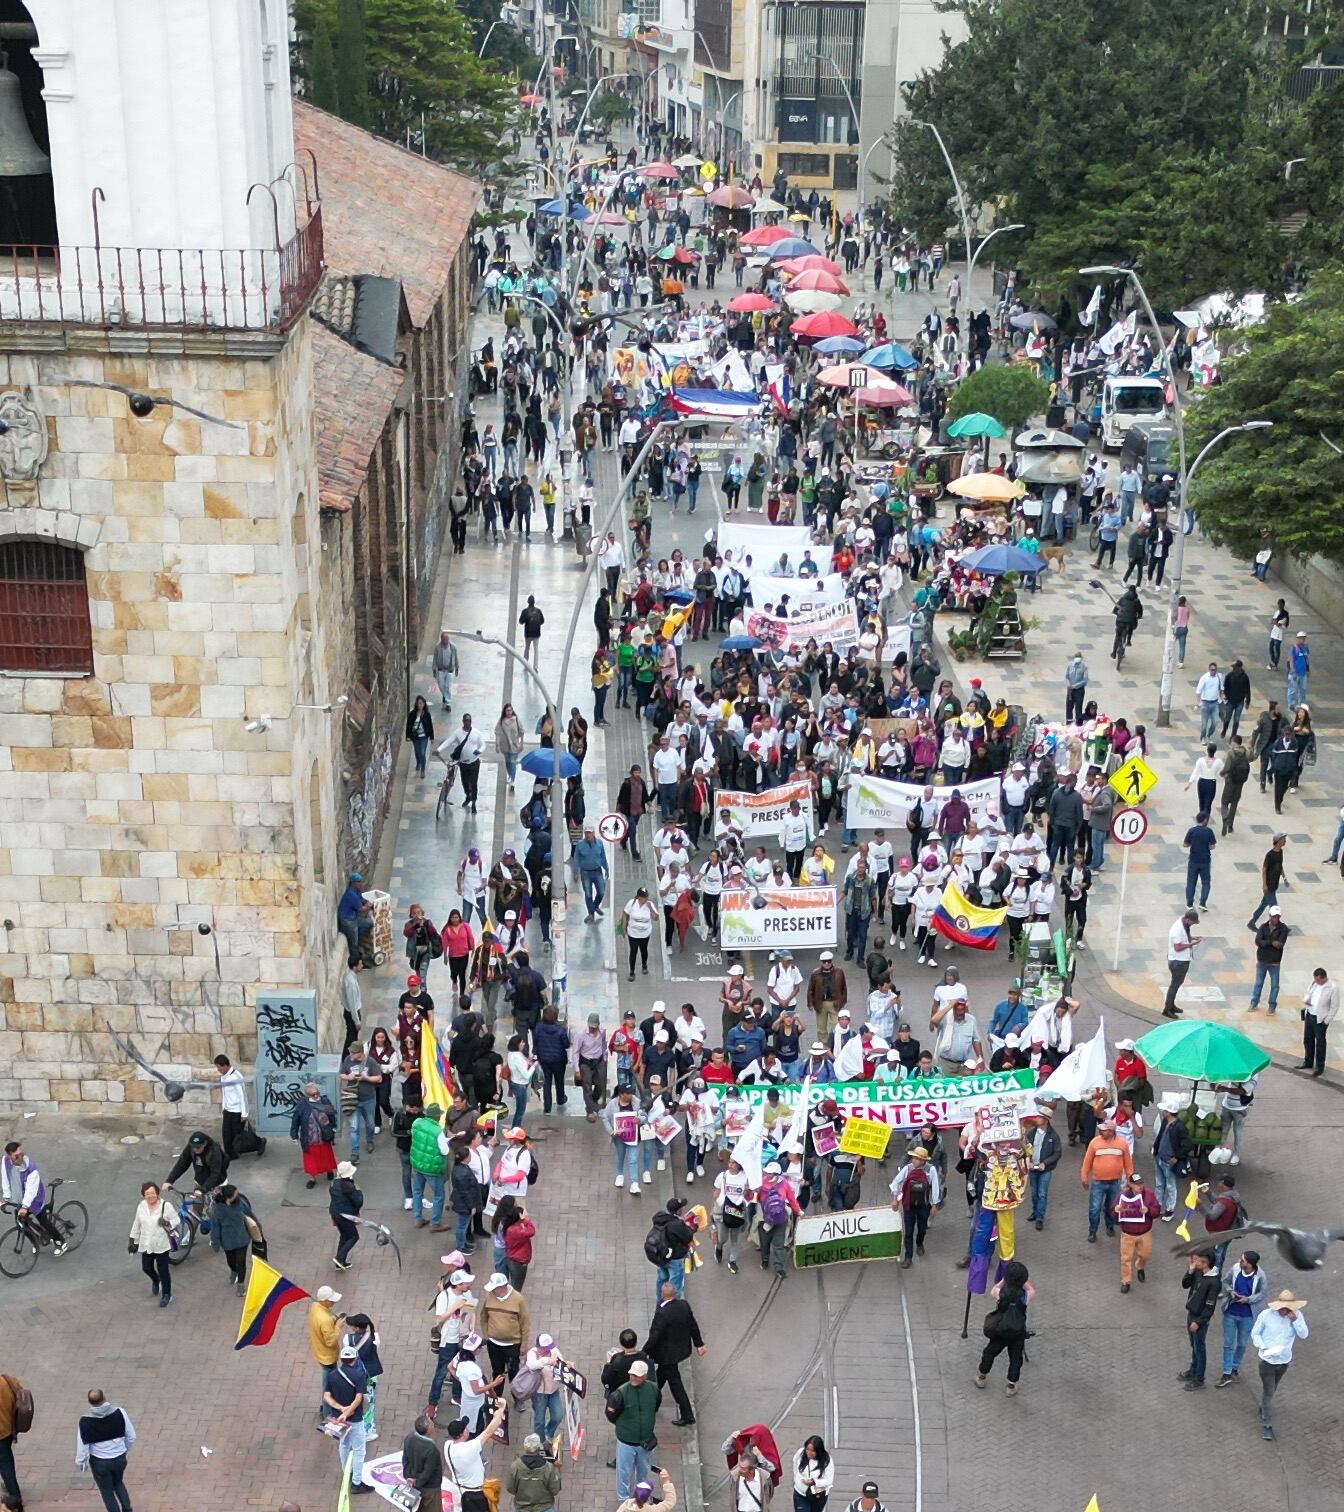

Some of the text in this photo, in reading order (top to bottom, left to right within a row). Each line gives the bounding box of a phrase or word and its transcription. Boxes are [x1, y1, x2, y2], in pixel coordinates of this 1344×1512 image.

[1120, 817, 1139, 835] 10
[764, 916, 832, 932] PRESENTE
[695, 952, 723, 966] PARE
[842, 1086, 869, 1103] DE
[819, 1215, 871, 1240] ANUC
